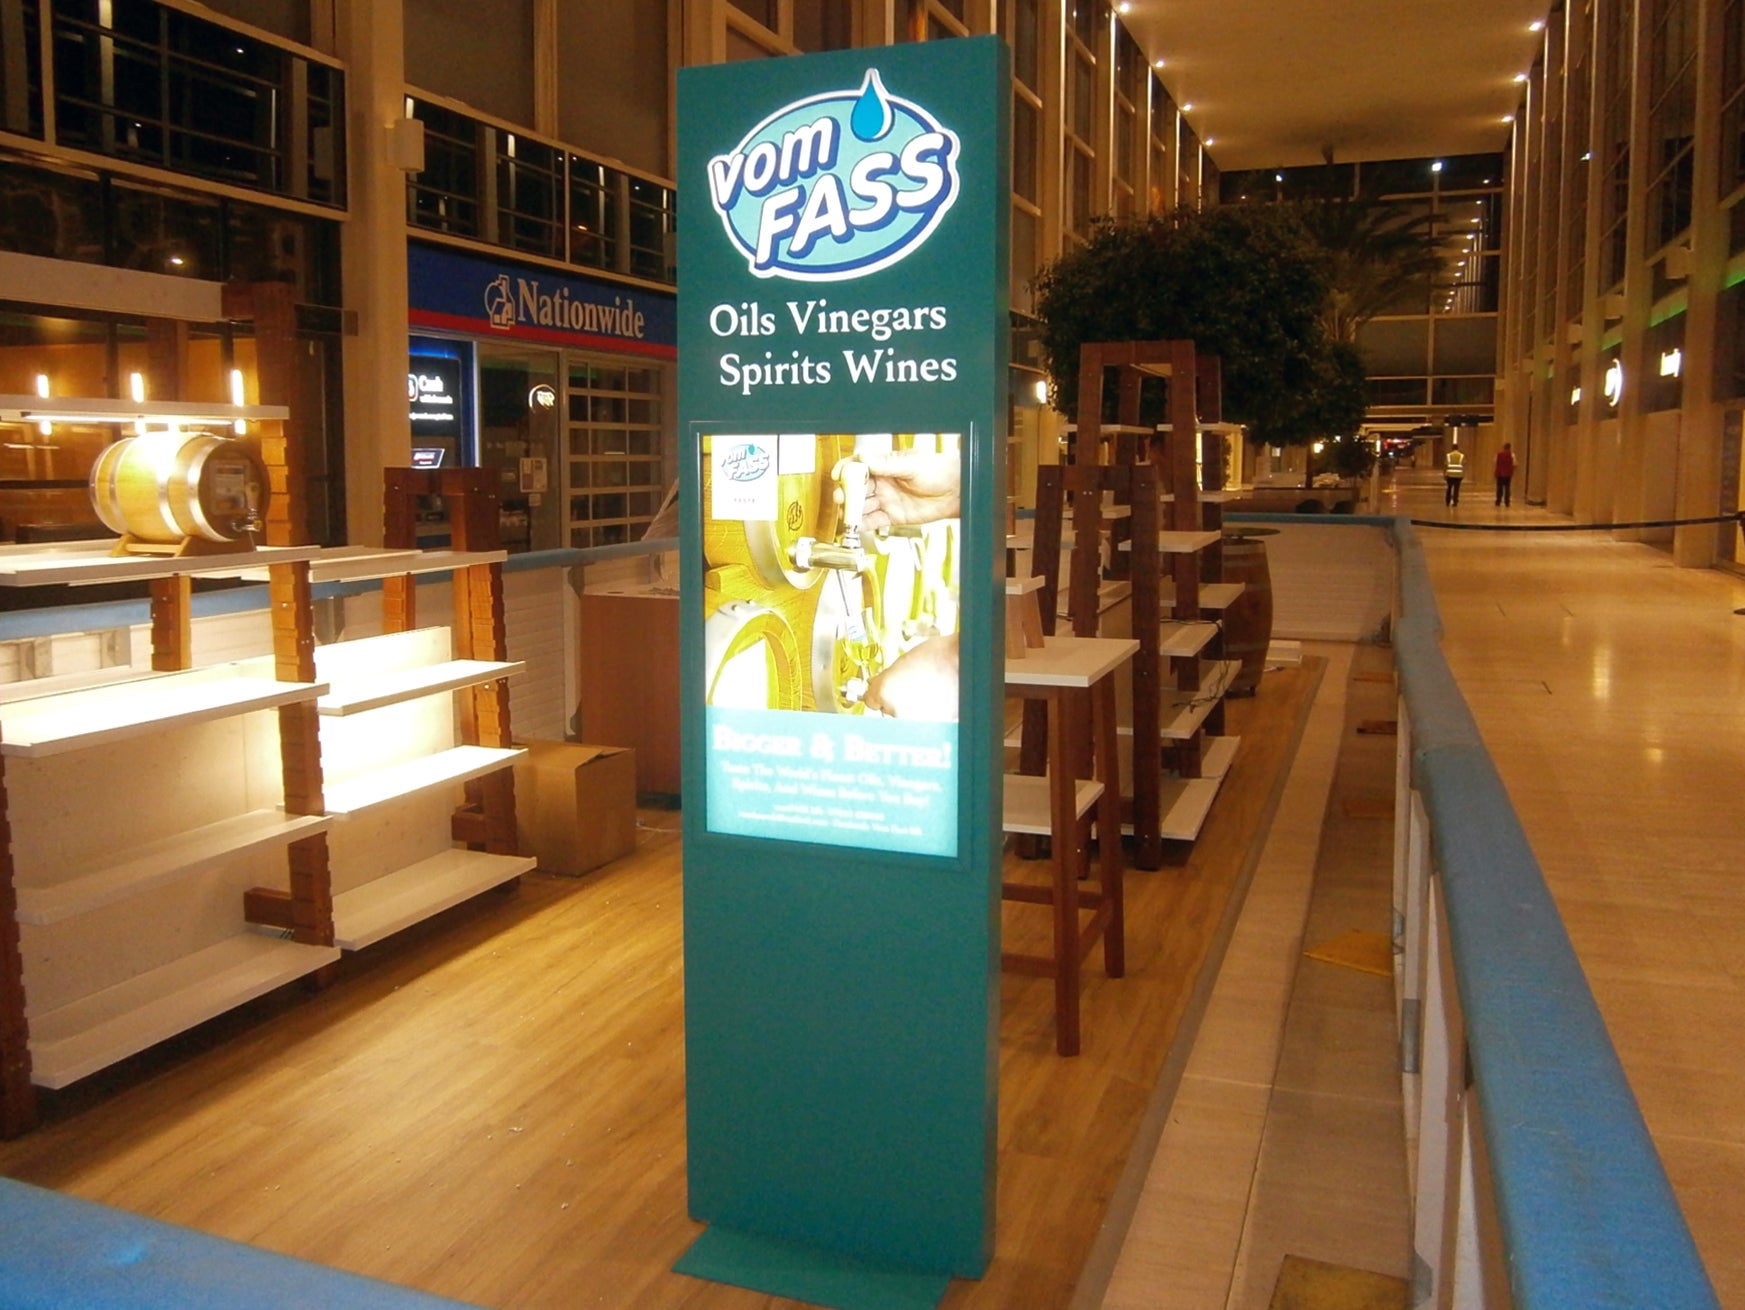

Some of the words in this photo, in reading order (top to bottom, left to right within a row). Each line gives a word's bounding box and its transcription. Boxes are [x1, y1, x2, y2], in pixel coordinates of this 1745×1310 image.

[754, 132, 951, 270] FASS
[516, 277, 645, 339] Nationwide
[709, 302, 776, 337] Oils
[786, 299, 947, 341] Vinegars
[719, 350, 831, 395] Spirits
[842, 347, 957, 384] Wines
